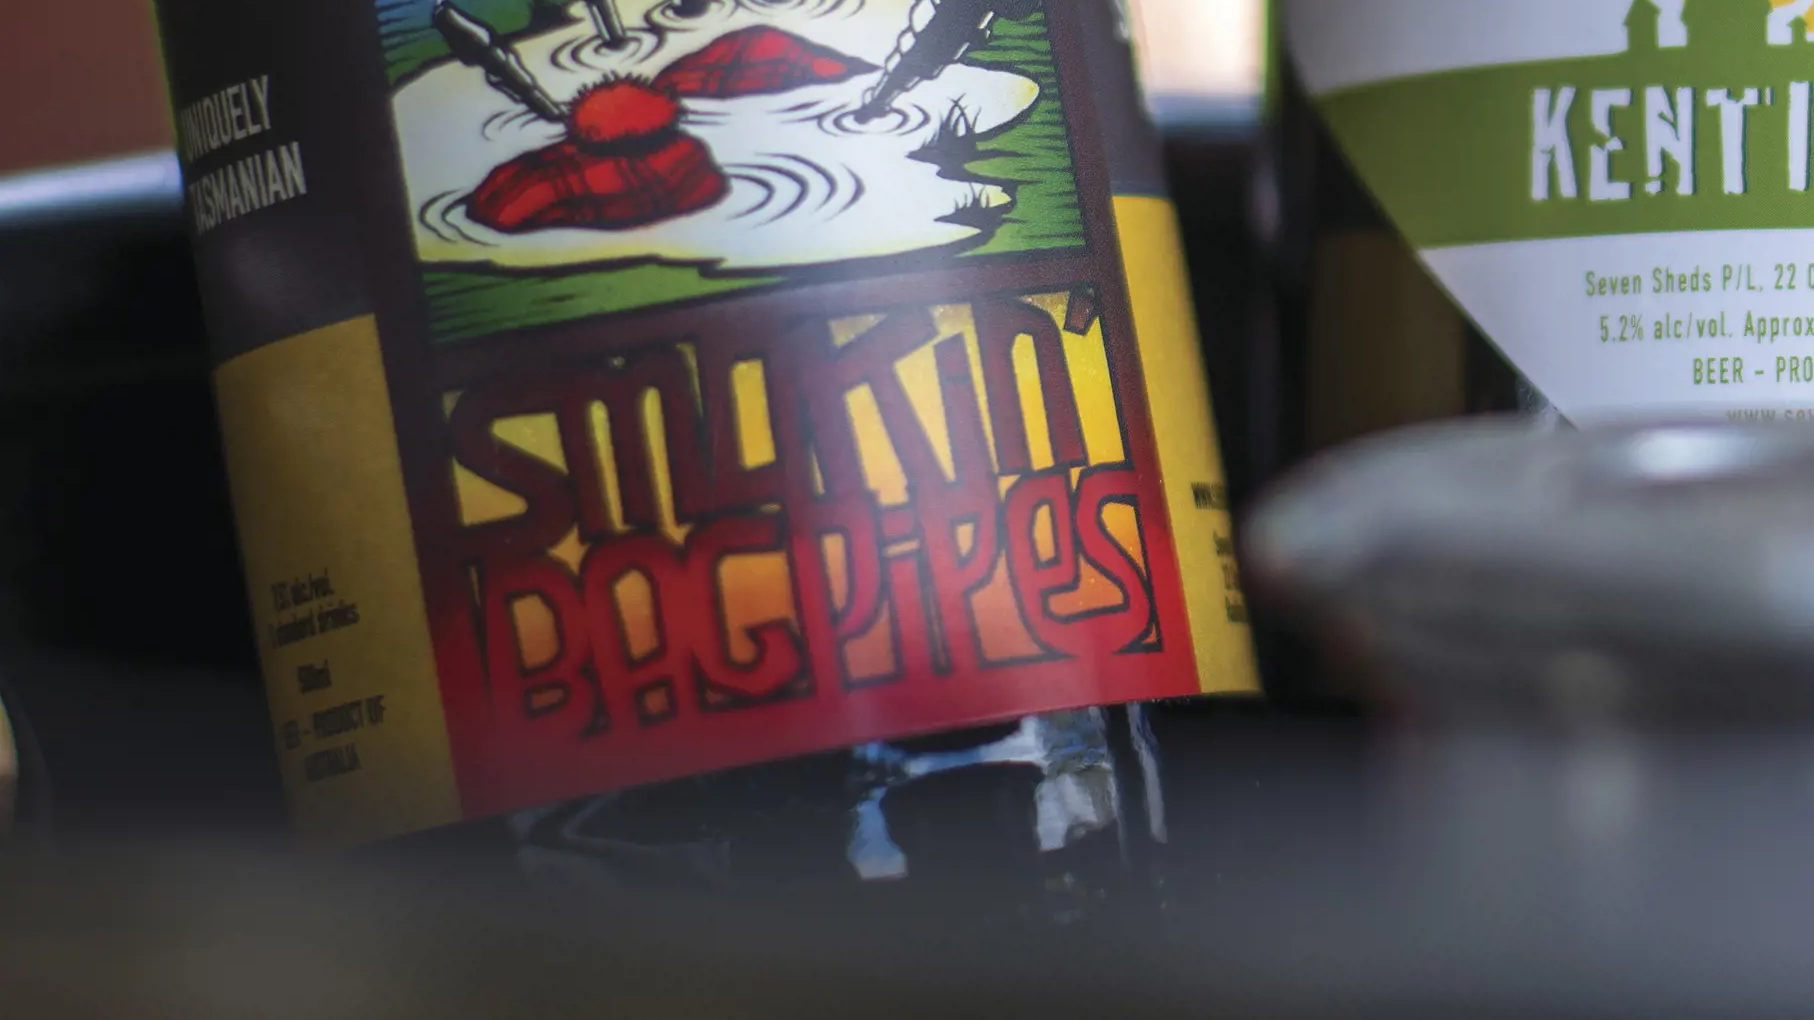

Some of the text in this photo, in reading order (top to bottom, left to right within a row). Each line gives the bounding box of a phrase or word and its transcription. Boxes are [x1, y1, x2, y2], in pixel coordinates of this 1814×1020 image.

[1584, 270, 1642, 298] Seven
[1652, 265, 1712, 294] Sheds
[1774, 262, 1797, 291] 22
[1600, 314, 1644, 343] 5.2%
[1653, 311, 1733, 341] alc/vol.
[1693, 356, 1744, 385] BEER
